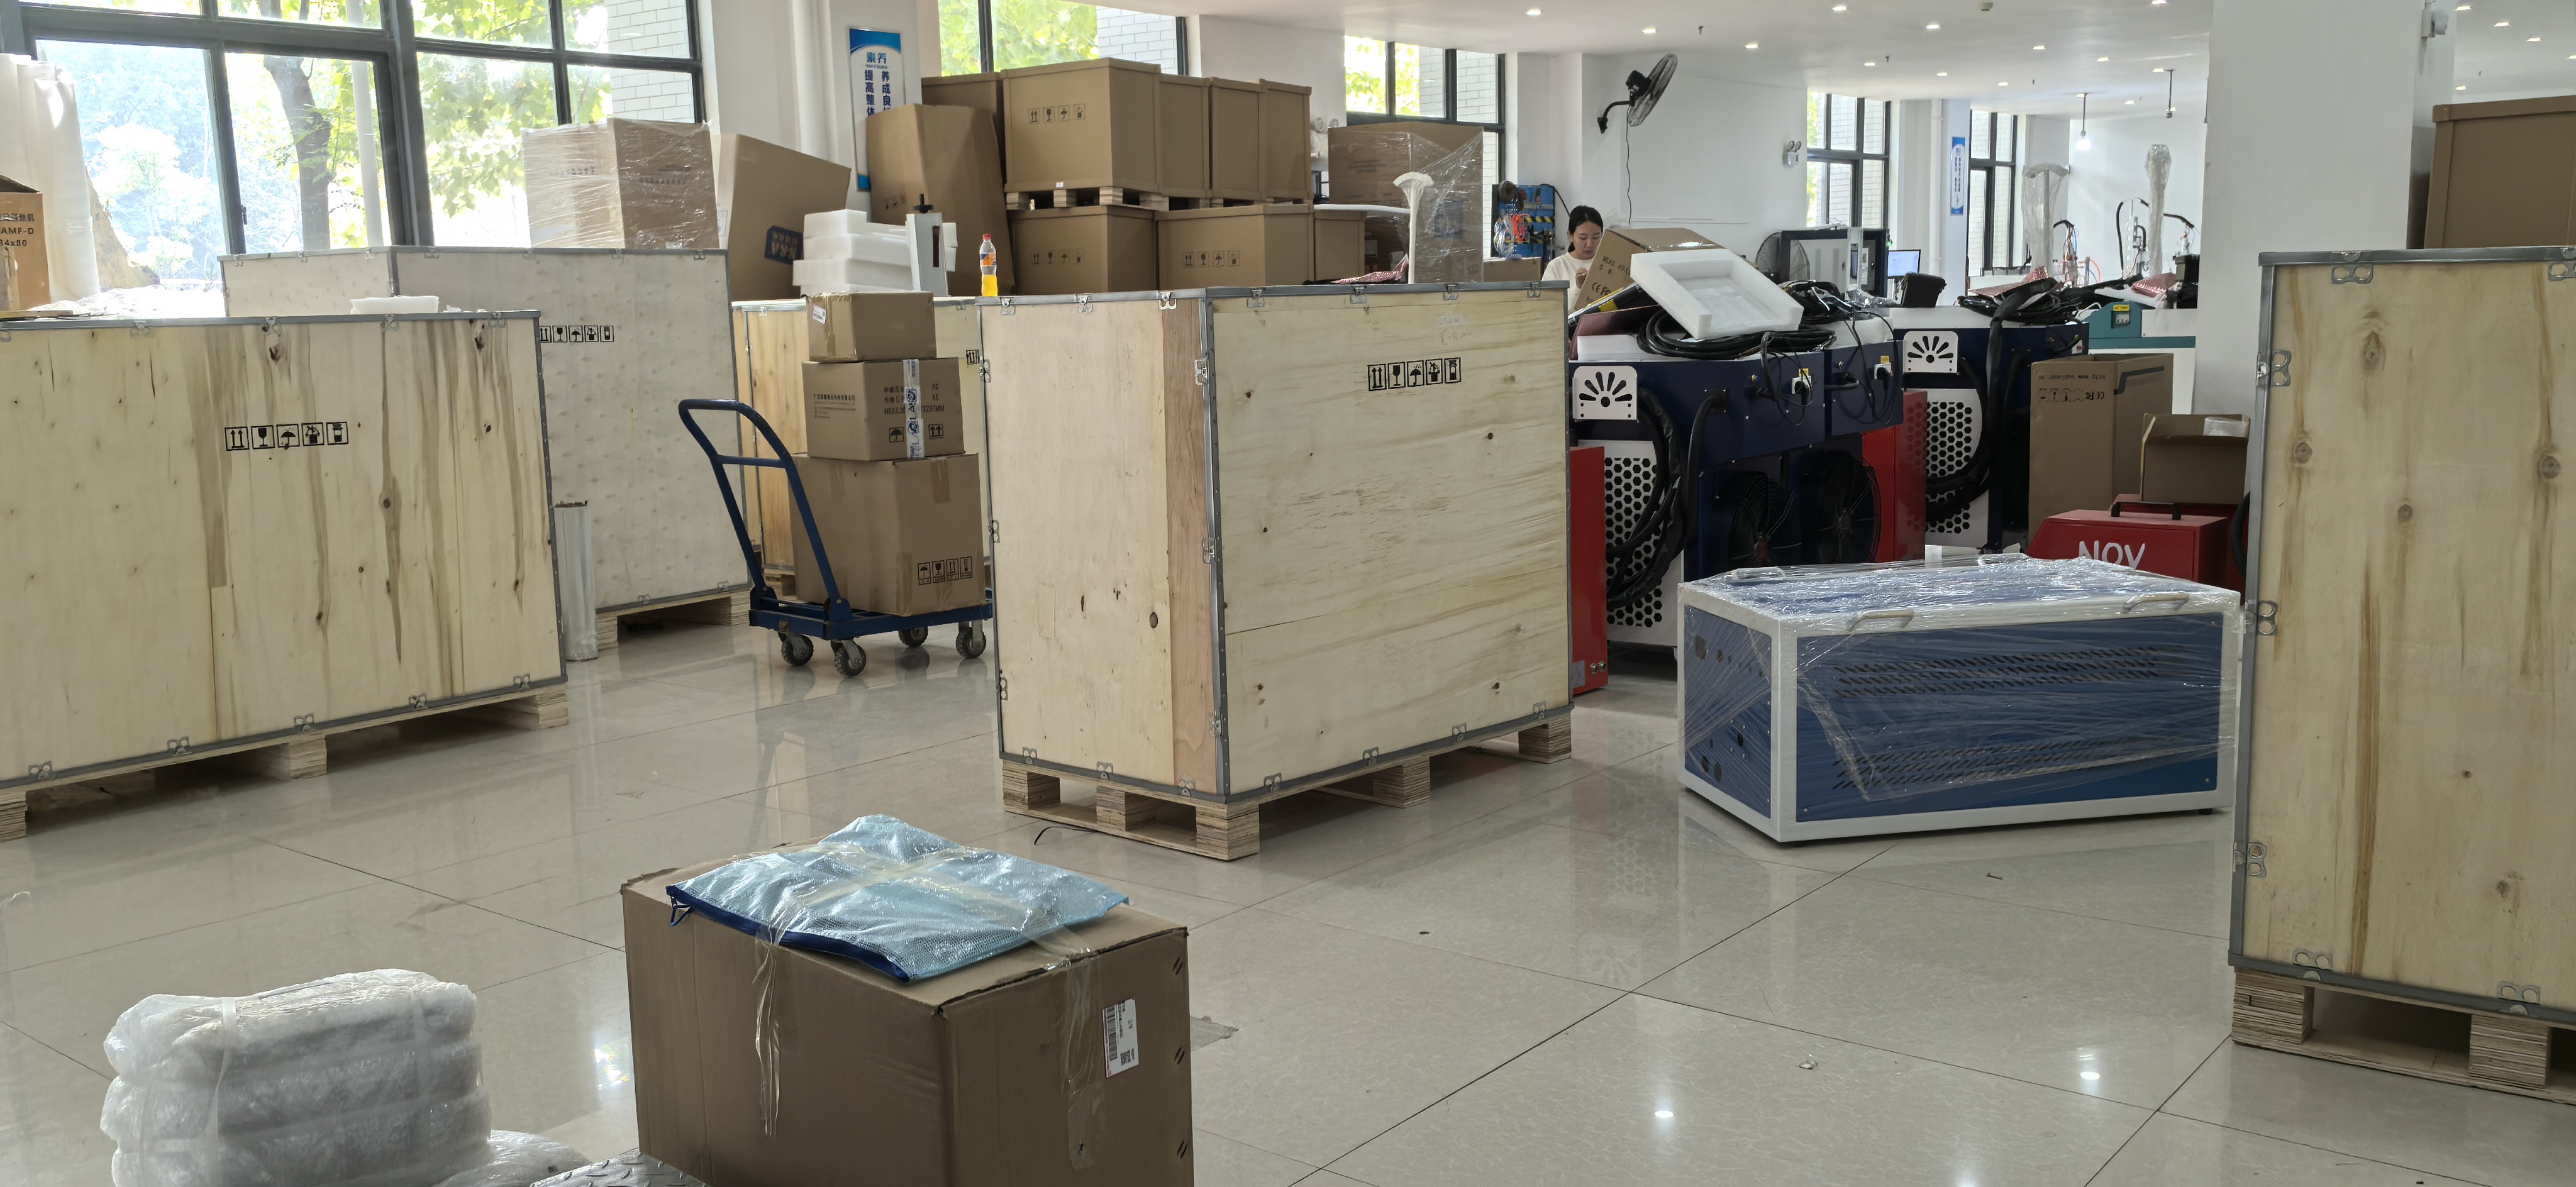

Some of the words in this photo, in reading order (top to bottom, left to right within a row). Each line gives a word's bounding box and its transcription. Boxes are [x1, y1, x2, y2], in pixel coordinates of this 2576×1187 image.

[881, 70, 891, 111] 养成良
[2079, 540, 2146, 570] NOV
